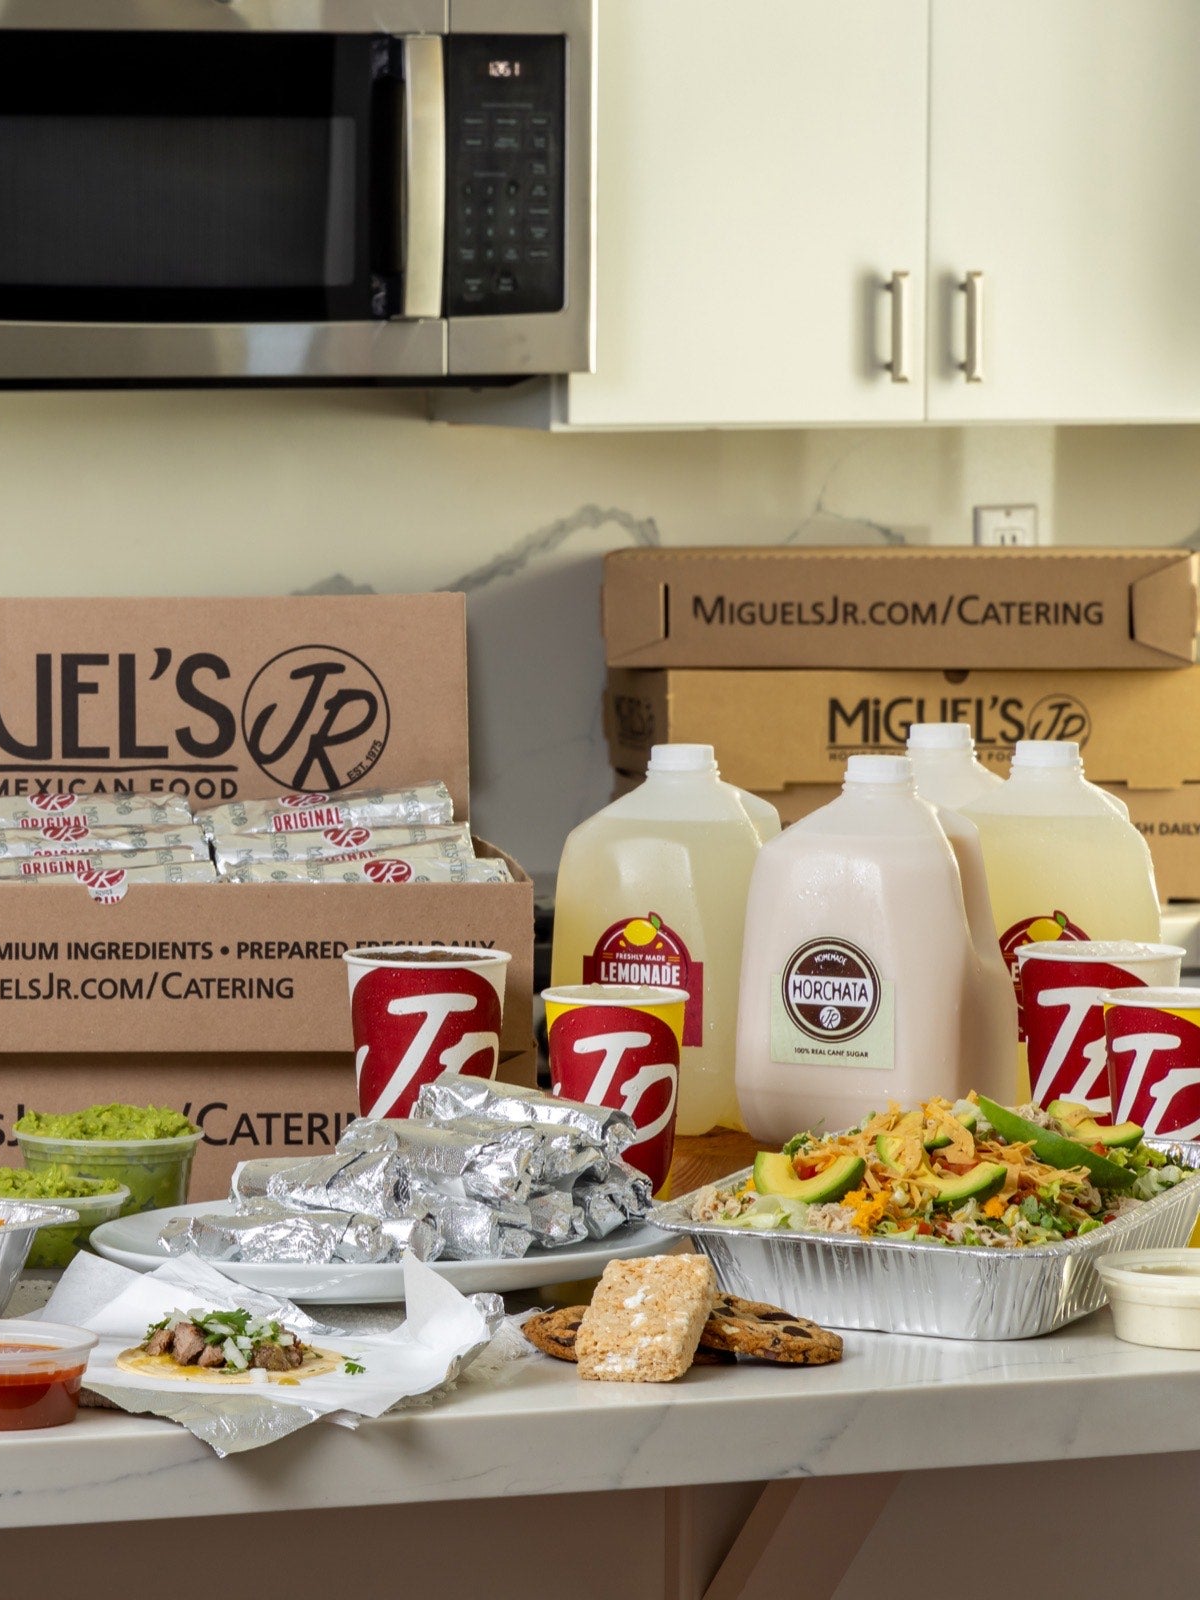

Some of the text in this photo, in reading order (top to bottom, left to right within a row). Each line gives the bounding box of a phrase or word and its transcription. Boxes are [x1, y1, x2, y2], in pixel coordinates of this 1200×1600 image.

[249, 661, 378, 790] JR
[346, 739, 383, 781] EST. 1975
[150, 778, 238, 801] FOOD
[273, 806, 344, 832] ORIGINAL
[22, 859, 96, 874] ORIGINAL
[66, 941, 214, 961] INGREDIENTS
[236, 941, 349, 960] PREPARED
[615, 952, 666, 962] FRESHLY MADE
[814, 952, 848, 966] HOMEMADE
[600, 961, 681, 986] LEMONADE
[792, 979, 869, 1002] HORCHATA
[820, 1008, 840, 1029] JR
[794, 1047, 810, 1055] 100%
[811, 1048, 827, 1056] REAL
[846, 1050, 869, 1058] SUGAR
